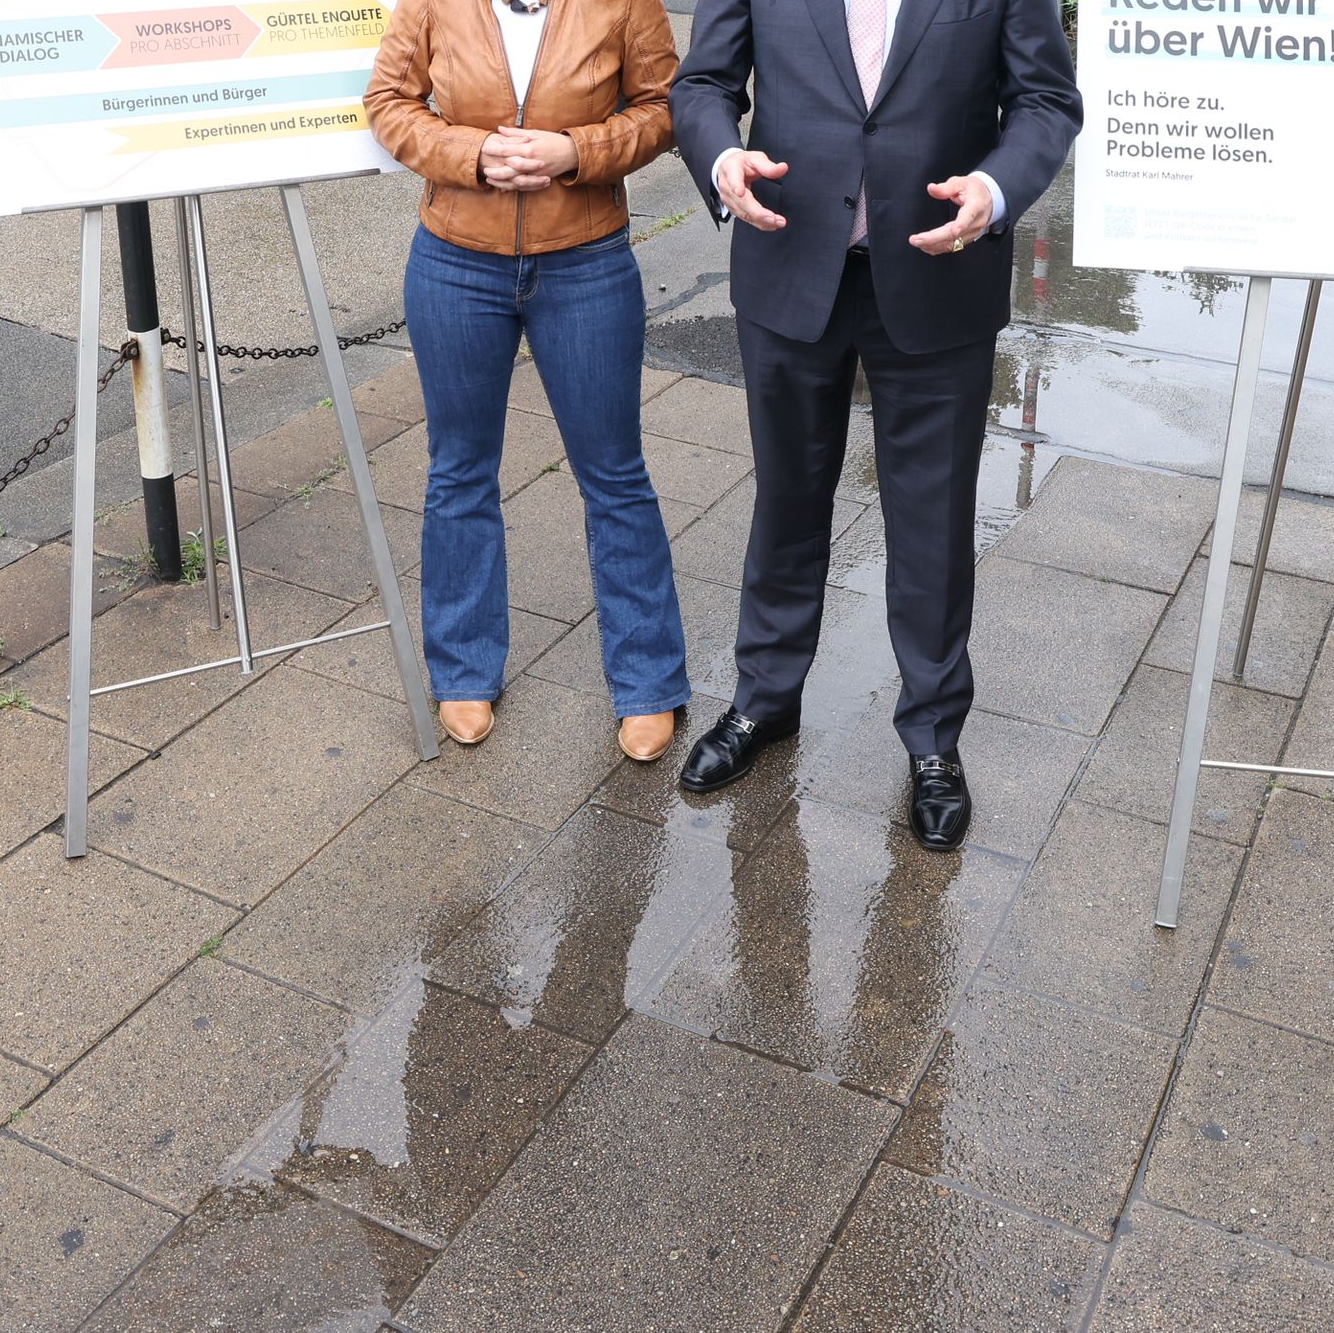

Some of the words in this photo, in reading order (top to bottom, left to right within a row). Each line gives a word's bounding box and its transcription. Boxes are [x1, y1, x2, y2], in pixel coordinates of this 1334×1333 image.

[135, 18, 233, 37] WORKSHOPS
[266, 11, 319, 28] GÜRTEL
[322, 7, 383, 25] ENQUETE
[130, 40, 160, 55] PRO
[164, 33, 242, 53] ABSCHNITT
[268, 27, 298, 43] PRO
[300, 22, 385, 41] THEMENFELD
[1107, 21, 1204, 57] über
[102, 93, 189, 112] Bürgerinnen
[192, 89, 219, 104] und
[221, 86, 268, 105] Bürger
[1107, 89, 1137, 108] Ich
[1143, 90, 1190, 110] höre
[1196, 95, 1225, 112] zu.
[184, 120, 267, 142] Expertinnen
[270, 117, 296, 132] und
[299, 111, 358, 132] Experten
[1107, 118, 1160, 139] Denn
[1166, 120, 1198, 139] wir
[1204, 122, 1275, 142] wollen
[1106, 139, 1205, 163] Probleme
[1212, 143, 1273, 164] lösen.
[1105, 169, 1140, 180] Stadtrat
[1143, 170, 1160, 180] Karl
[1162, 171, 1194, 182] Mahrer
